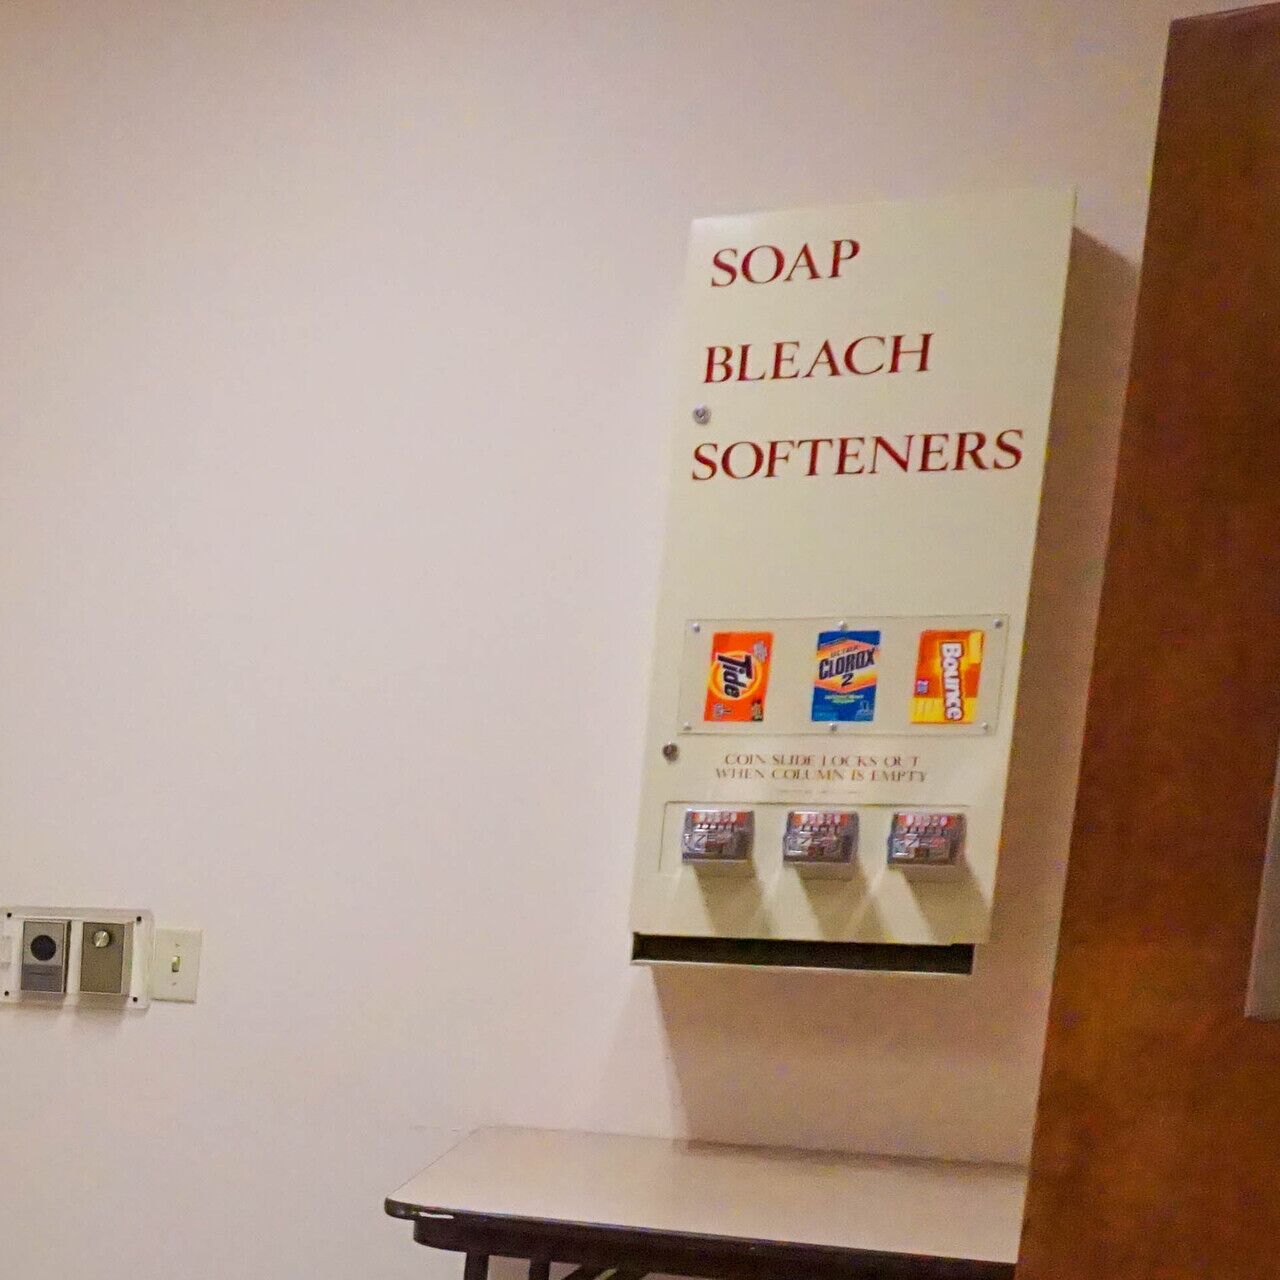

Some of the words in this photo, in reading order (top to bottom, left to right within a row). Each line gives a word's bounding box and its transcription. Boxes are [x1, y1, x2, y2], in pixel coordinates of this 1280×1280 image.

[711, 238, 861, 288] SOAP
[702, 332, 934, 384] BLEACH
[691, 428, 1025, 481] SOFTENERS
[717, 654, 753, 699] Tide
[818, 647, 876, 680] CLOROX
[841, 672, 854, 687] 2
[941, 642, 963, 721] Bounce
[715, 767, 765, 780] WHEN
[771, 767, 844, 781] COLUMN
[870, 769, 928, 783] EMPTY
[724, 753, 766, 766] COIN
[772, 753, 815, 767] SLIDE
